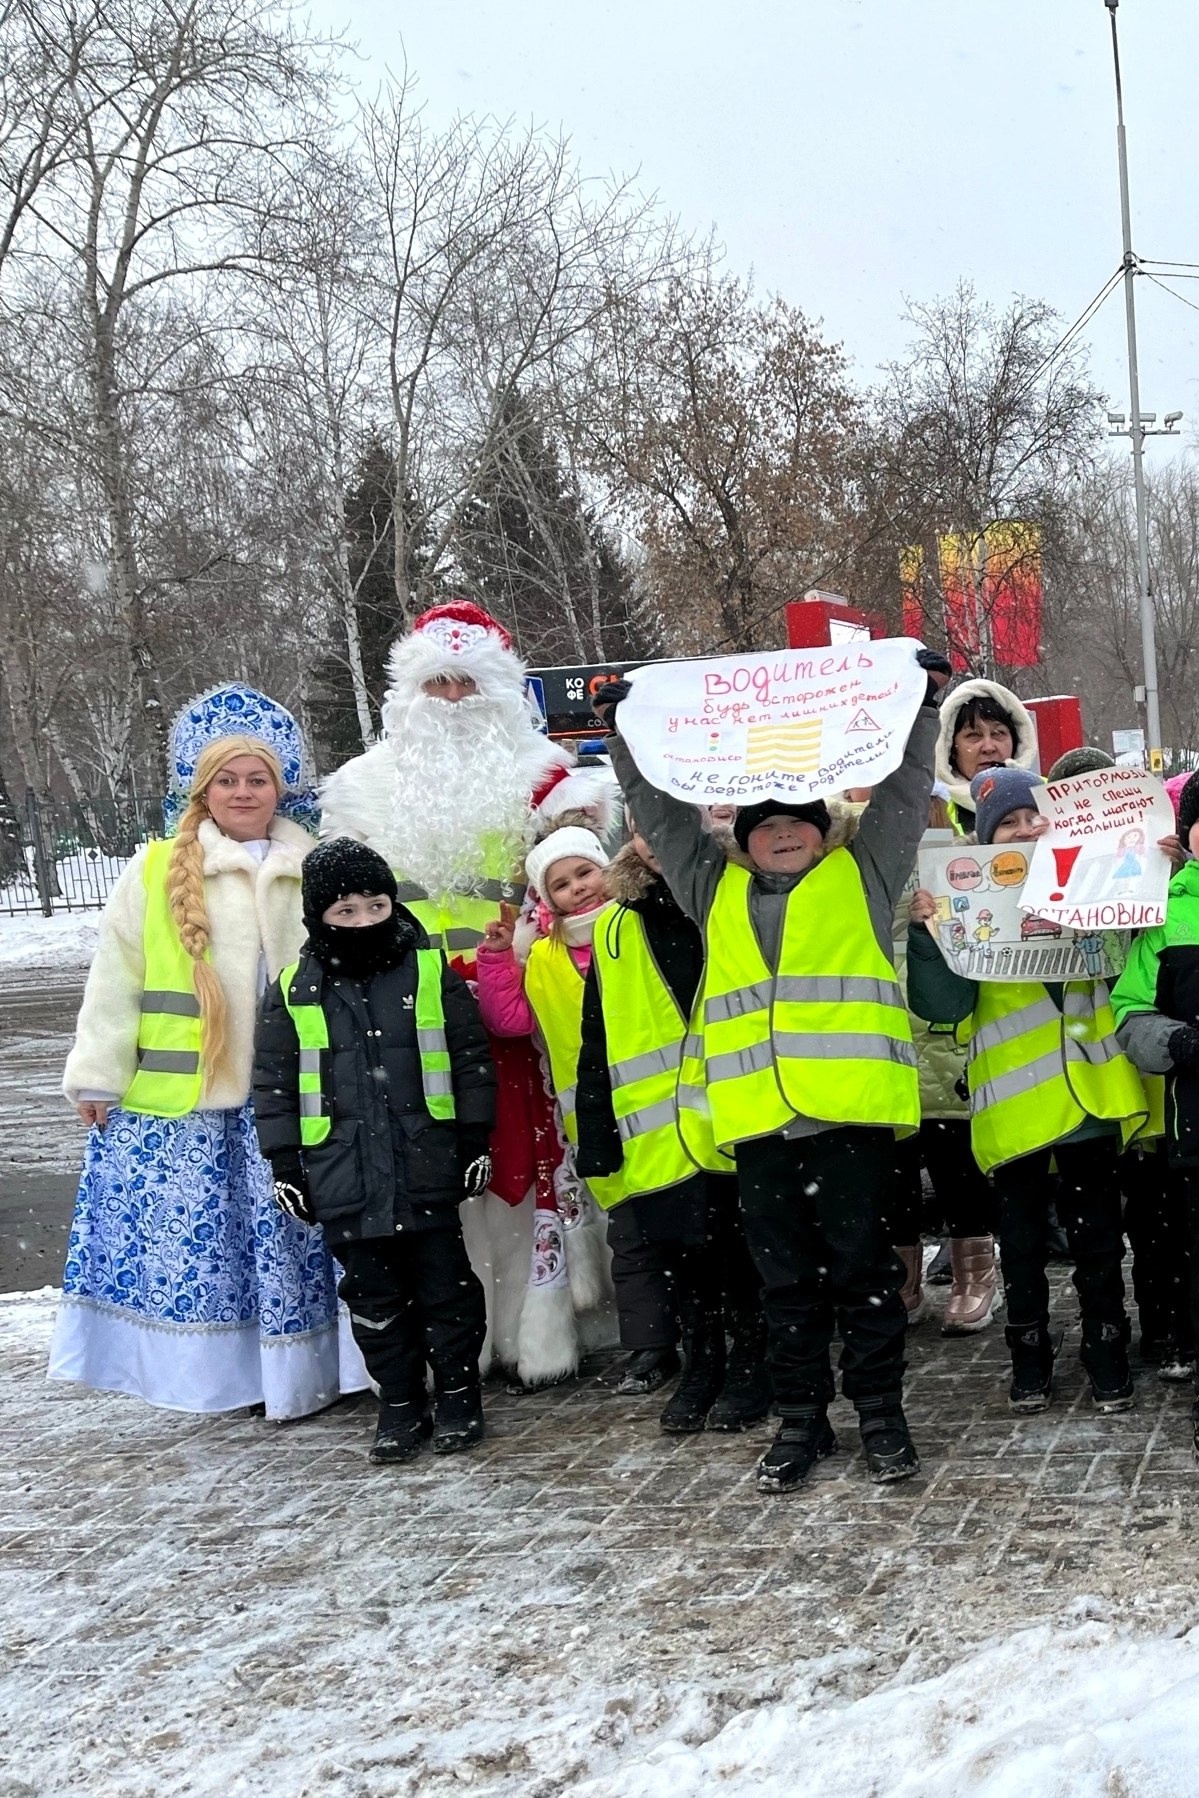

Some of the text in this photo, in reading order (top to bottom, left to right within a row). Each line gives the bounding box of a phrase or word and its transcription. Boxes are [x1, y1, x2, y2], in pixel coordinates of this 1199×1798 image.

[566, 677, 584, 689] КО
[567, 689, 584, 700] ФЕ
[705, 653, 873, 701] Водитель
[669, 717, 679, 732] у
[685, 715, 721, 726] нас
[733, 713, 772, 726] нет
[780, 699, 847, 719] лишних
[703, 680, 862, 719] будь осторожен
[704, 784, 748, 797] ведь
[752, 781, 798, 793] тоже
[809, 741, 890, 793] родители!
[728, 770, 806, 786] гоните
[817, 728, 896, 778] водители
[1046, 769, 1148, 802] ПРИТОРМОЗИ
